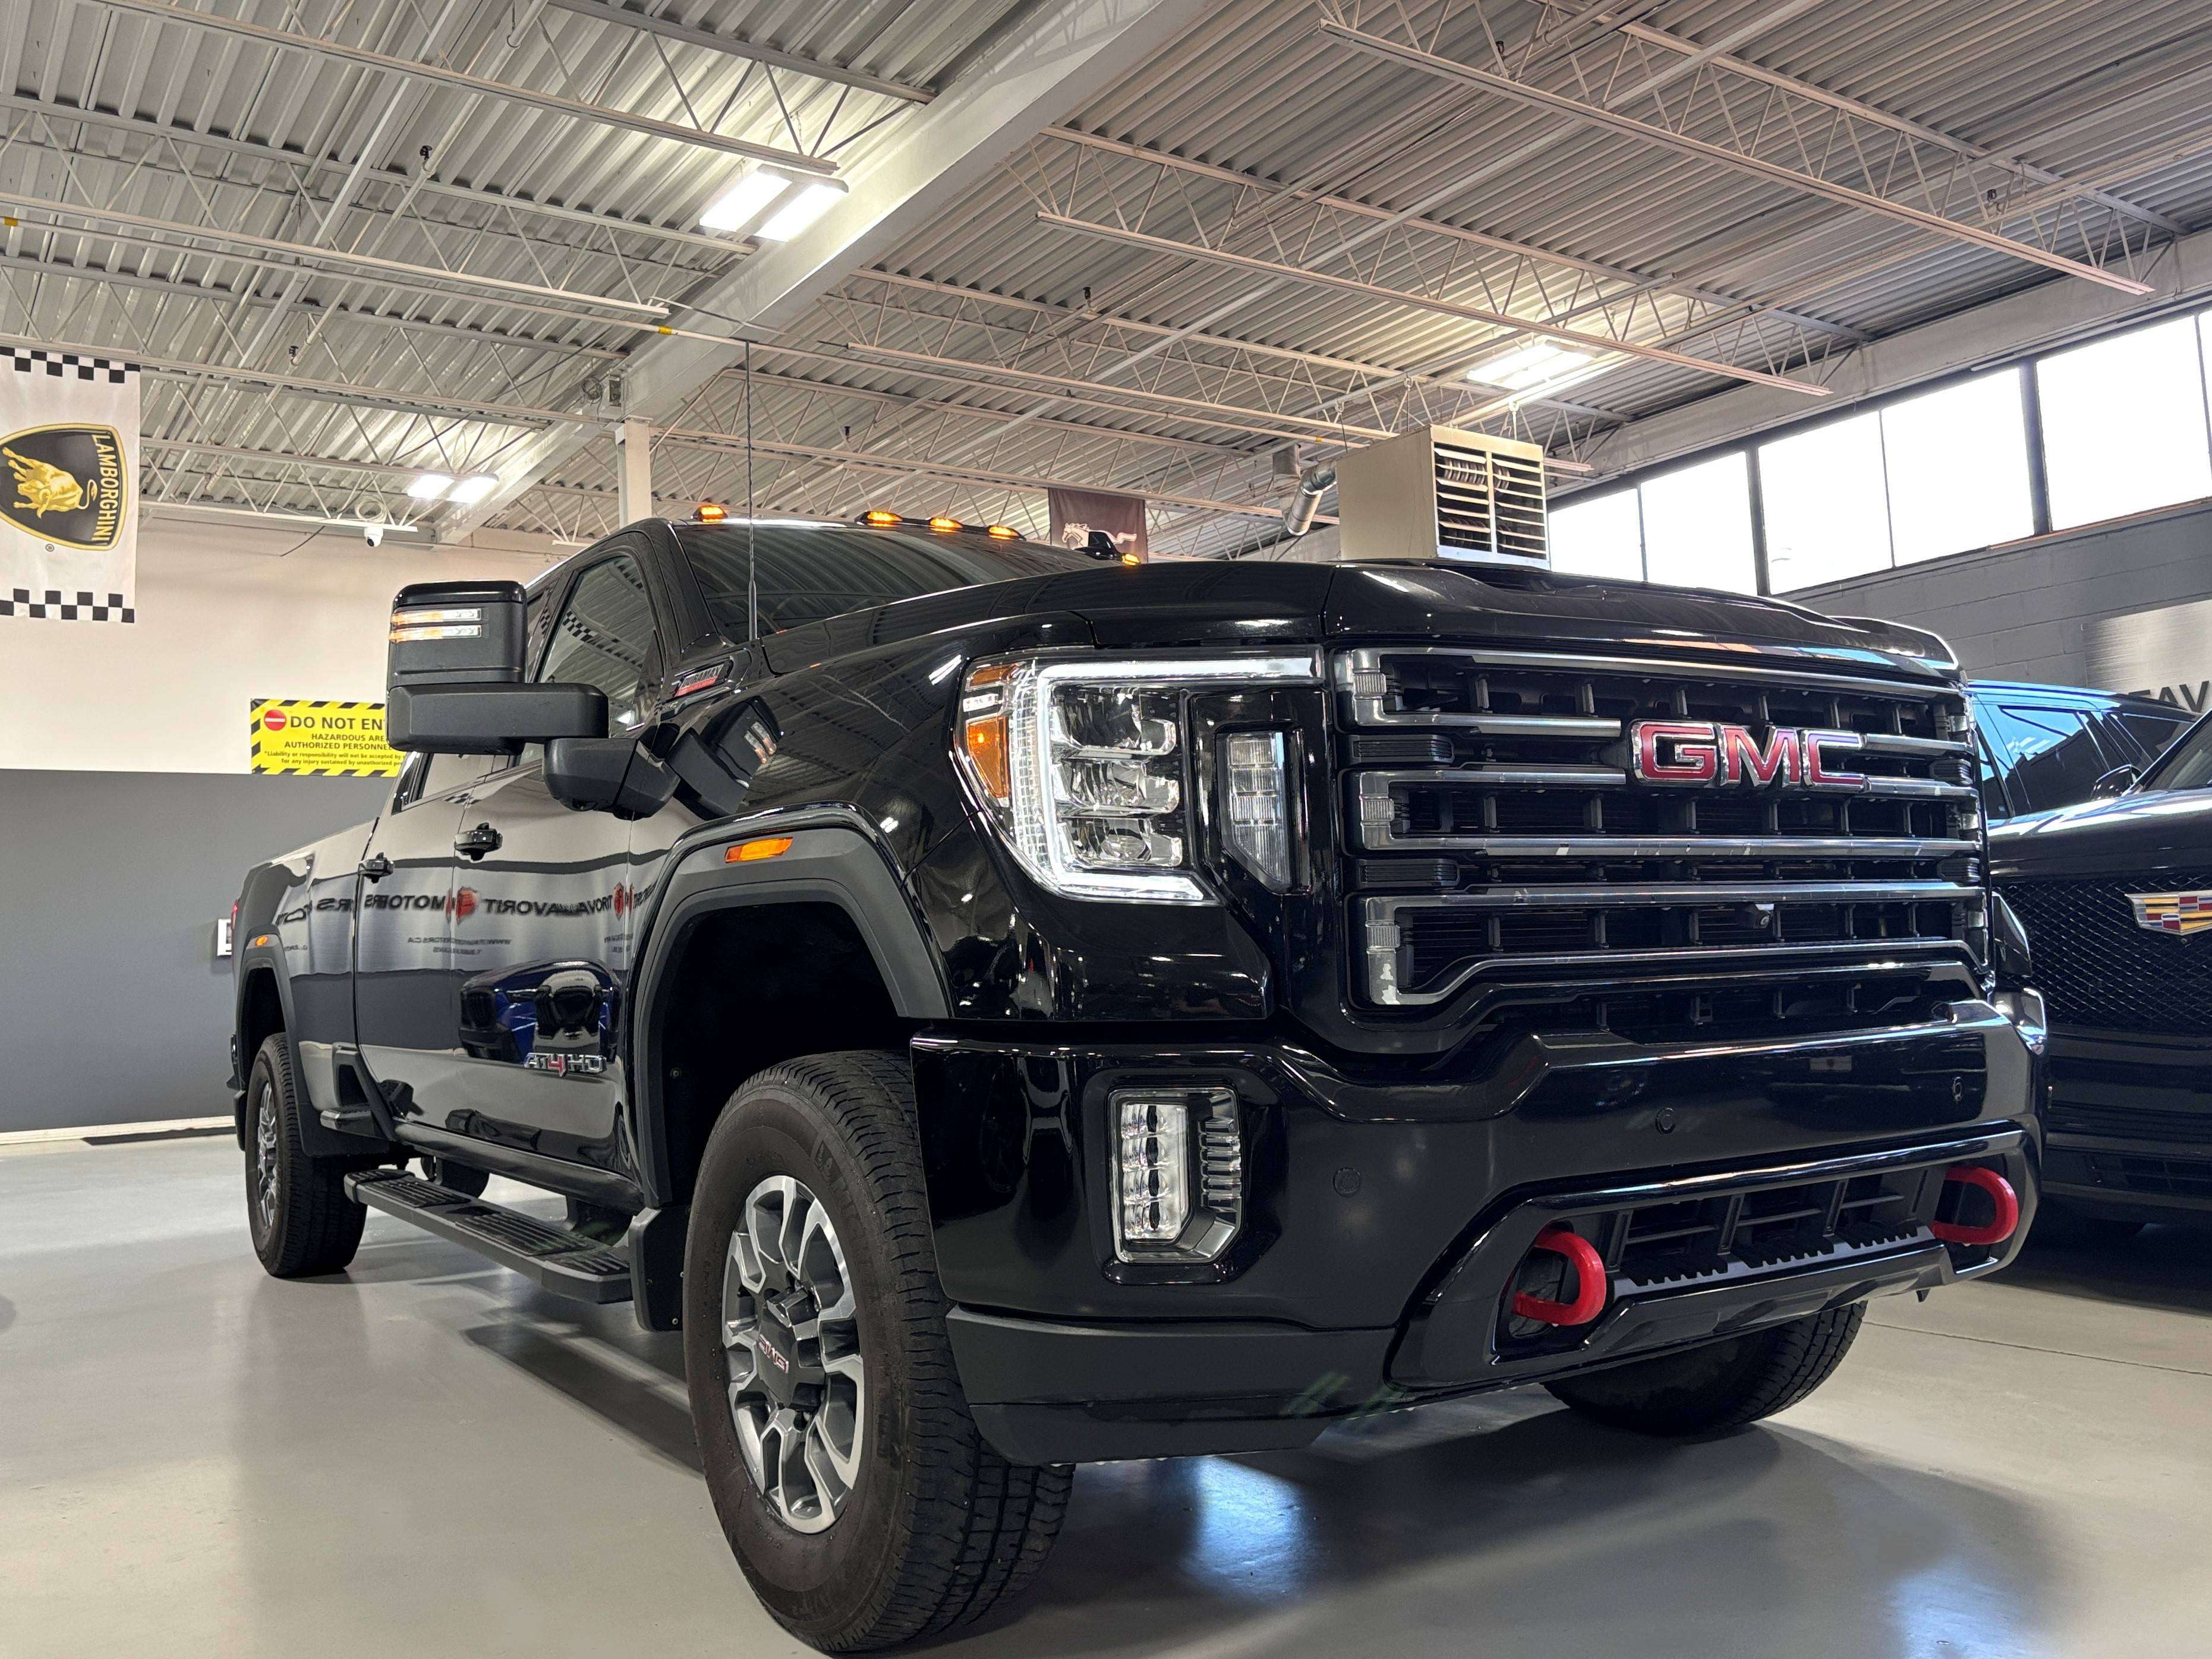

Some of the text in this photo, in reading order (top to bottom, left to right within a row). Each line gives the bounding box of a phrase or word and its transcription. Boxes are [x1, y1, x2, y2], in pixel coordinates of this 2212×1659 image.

[92, 434, 119, 541] LAMBORGHINI
[2128, 680, 2210, 713] AV
[290, 716, 385, 730] DO NOT EN
[311, 733, 365, 742] HAZARDOUS
[1631, 720, 1866, 790] GMC
